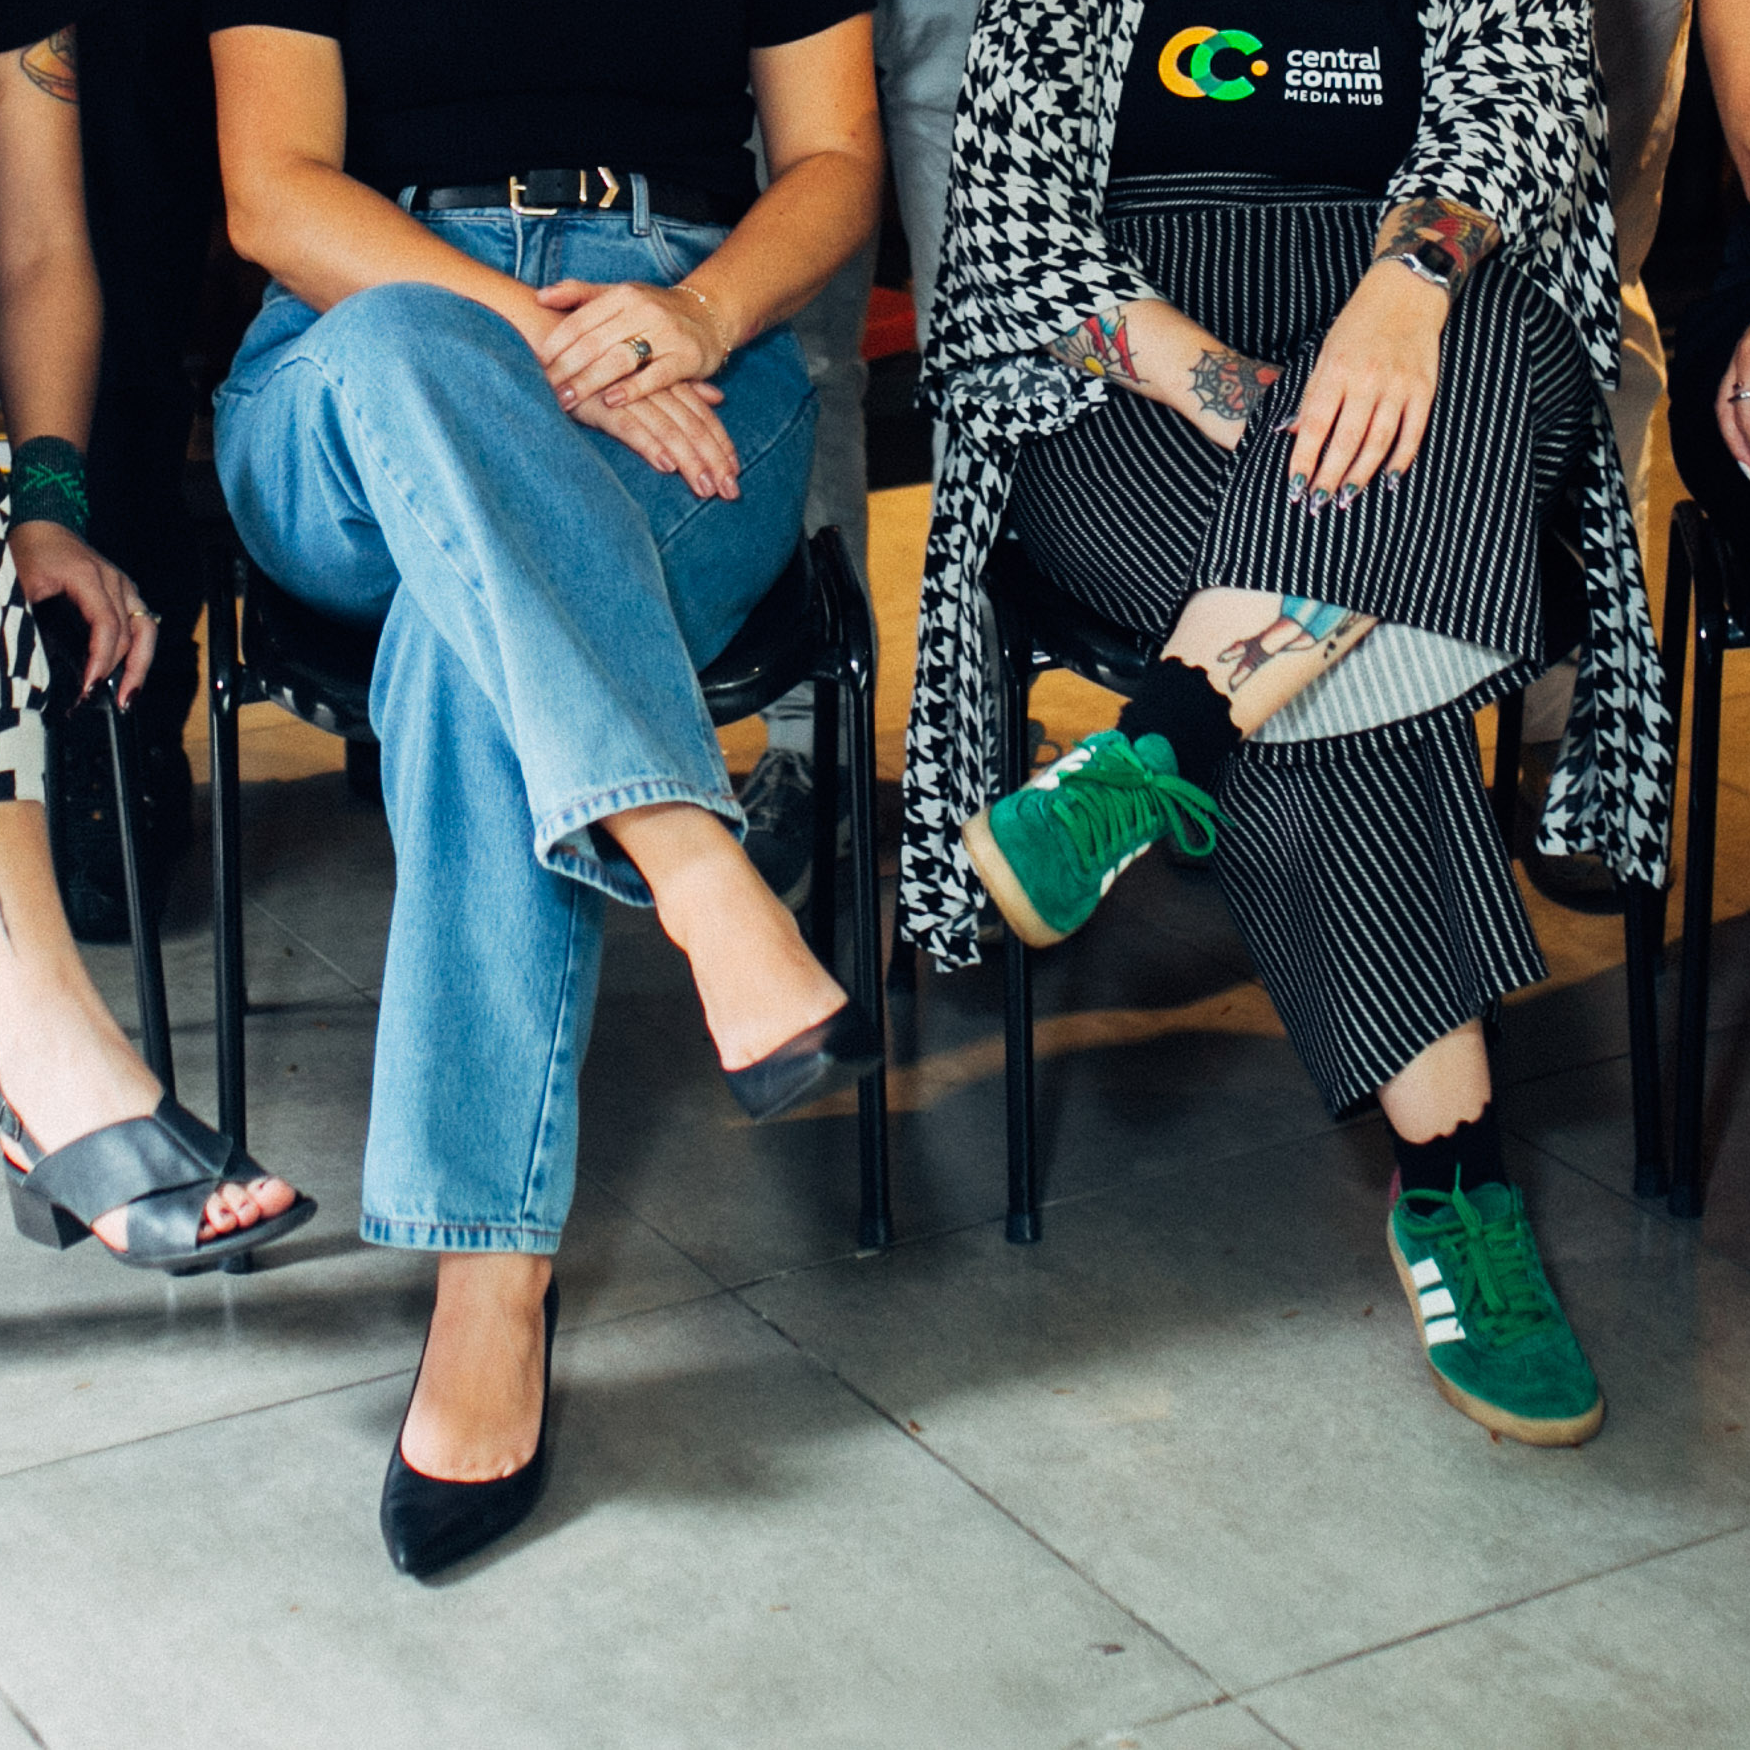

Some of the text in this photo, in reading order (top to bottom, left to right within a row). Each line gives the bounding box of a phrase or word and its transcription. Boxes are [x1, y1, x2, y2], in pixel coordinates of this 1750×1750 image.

[1286, 46, 1381, 70] central
[1285, 68, 1383, 90] comm
[1284, 89, 1383, 106] MEDIA HUB
